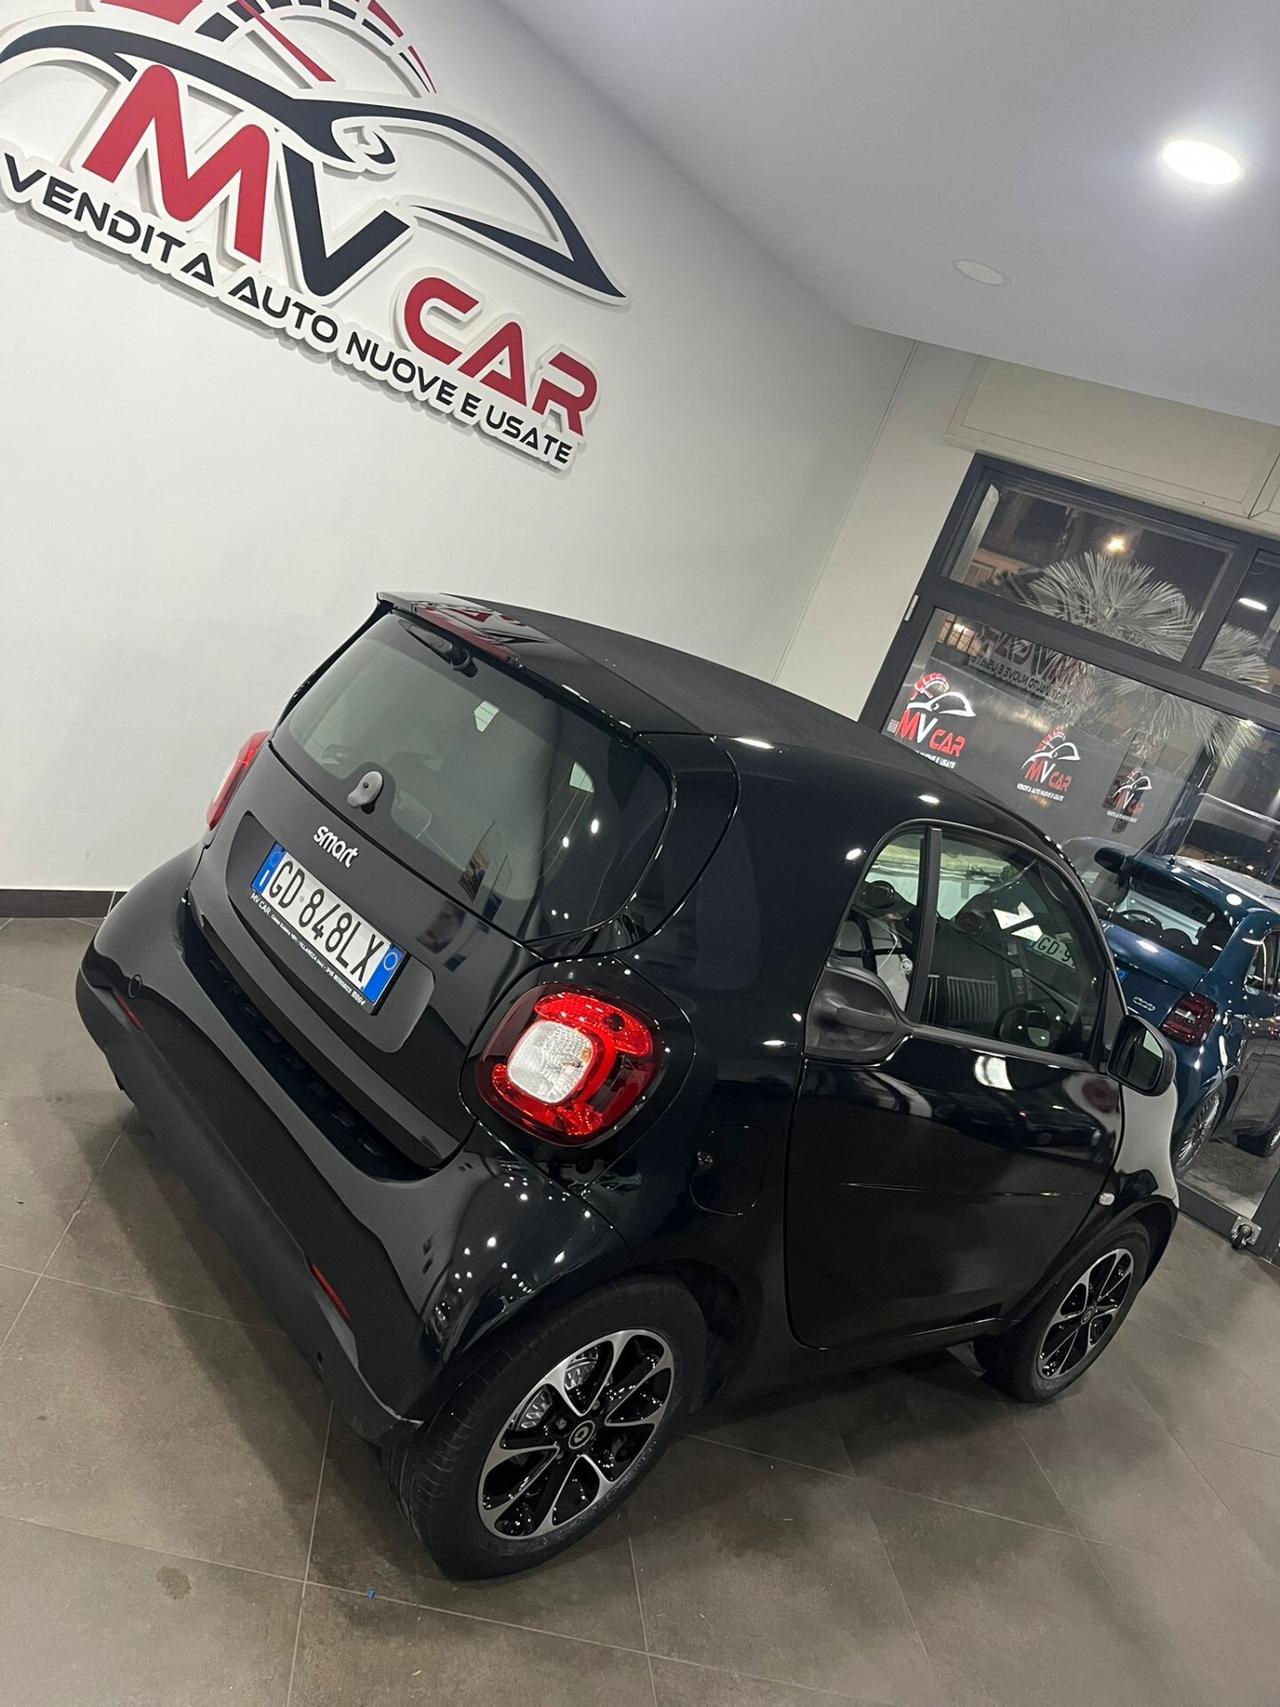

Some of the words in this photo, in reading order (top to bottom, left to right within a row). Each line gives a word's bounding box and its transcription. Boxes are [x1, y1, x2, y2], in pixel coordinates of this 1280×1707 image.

[81, 64, 411, 298] MV
[403, 276, 599, 437] CAR
[3, 152, 217, 288] VENDITA
[228, 275, 339, 344] AUTO
[345, 331, 459, 407] NUOVE
[461, 394, 483, 419] E
[486, 404, 574, 464] USATE
[894, 708, 939, 744] MV
[929, 729, 966, 757] CAR
[1024, 757, 1056, 784] MV
[1048, 771, 1073, 792] CAR
[313, 825, 360, 868] smart
[268, 860, 305, 909] GD
[298, 888, 385, 983] 848LX
[1037, 937, 1060, 956] GD
